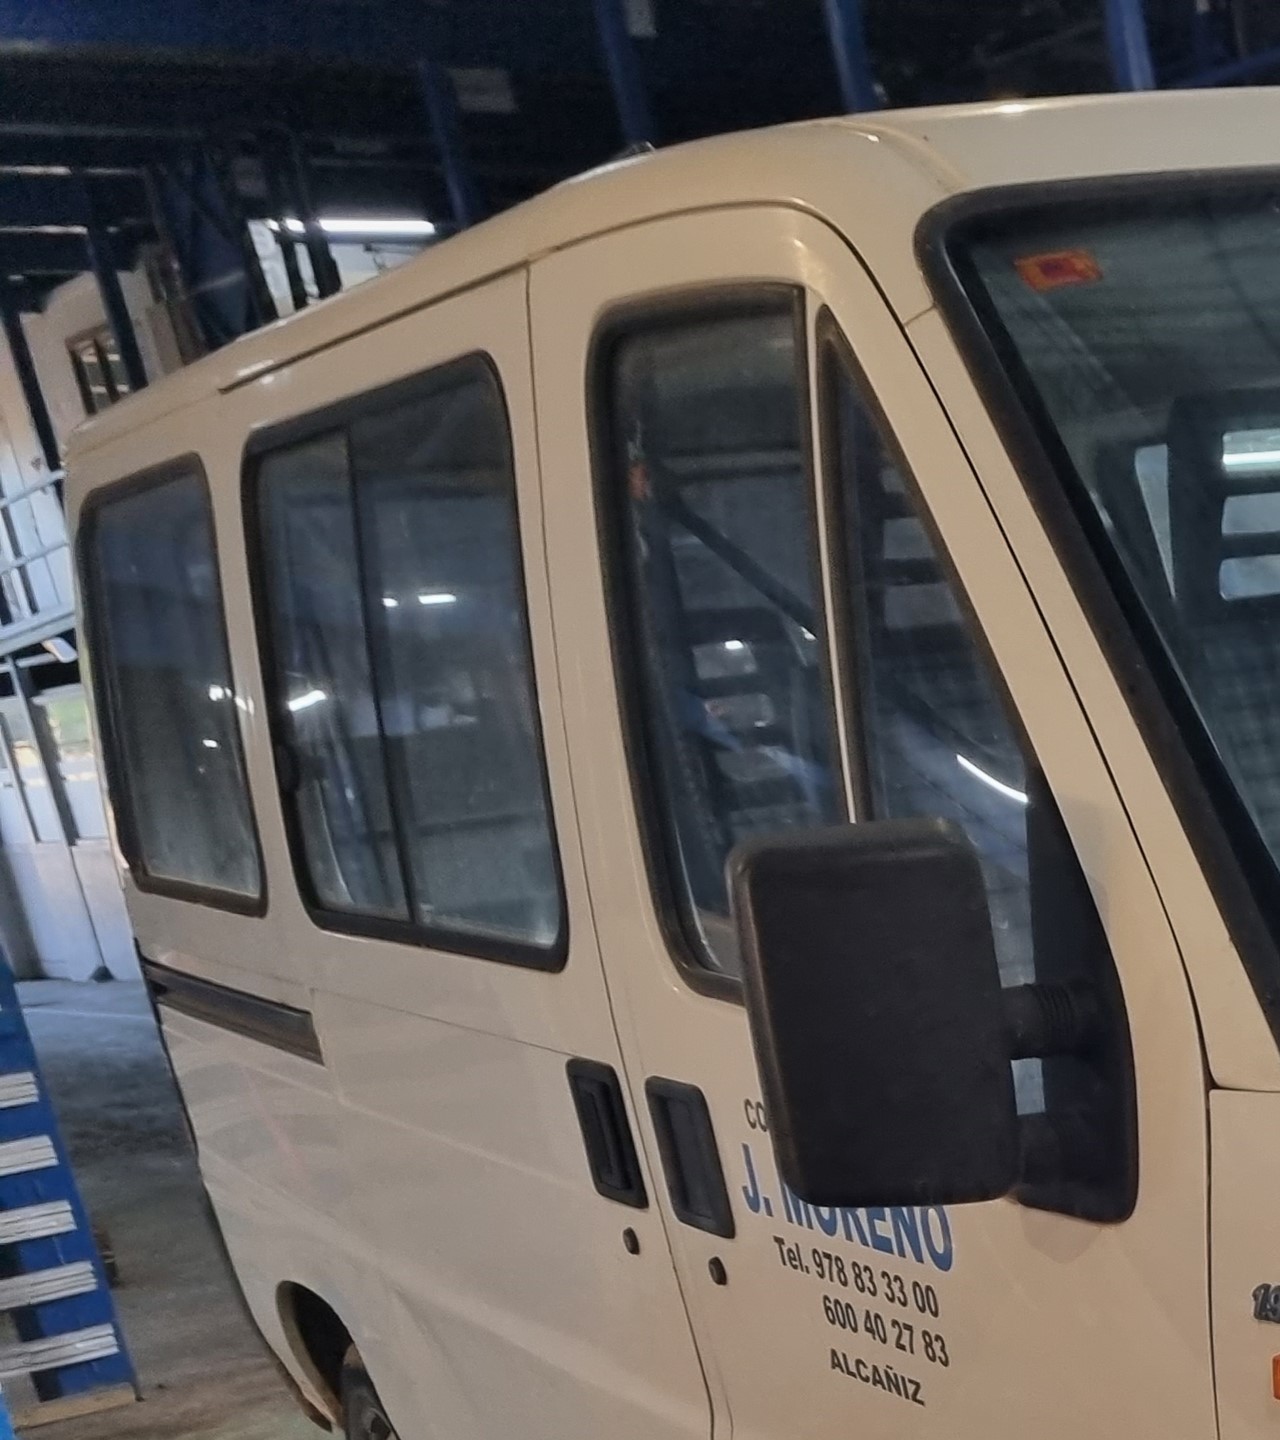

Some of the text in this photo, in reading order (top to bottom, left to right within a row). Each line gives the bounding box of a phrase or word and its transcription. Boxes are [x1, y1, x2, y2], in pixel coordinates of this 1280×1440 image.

[741, 1142, 774, 1218] J.
[773, 1235, 939, 1318] Tel. 978 83 33 00
[823, 1295, 949, 1367] 600 40 27 83
[830, 1348, 926, 1406] ALCAÑIZ
